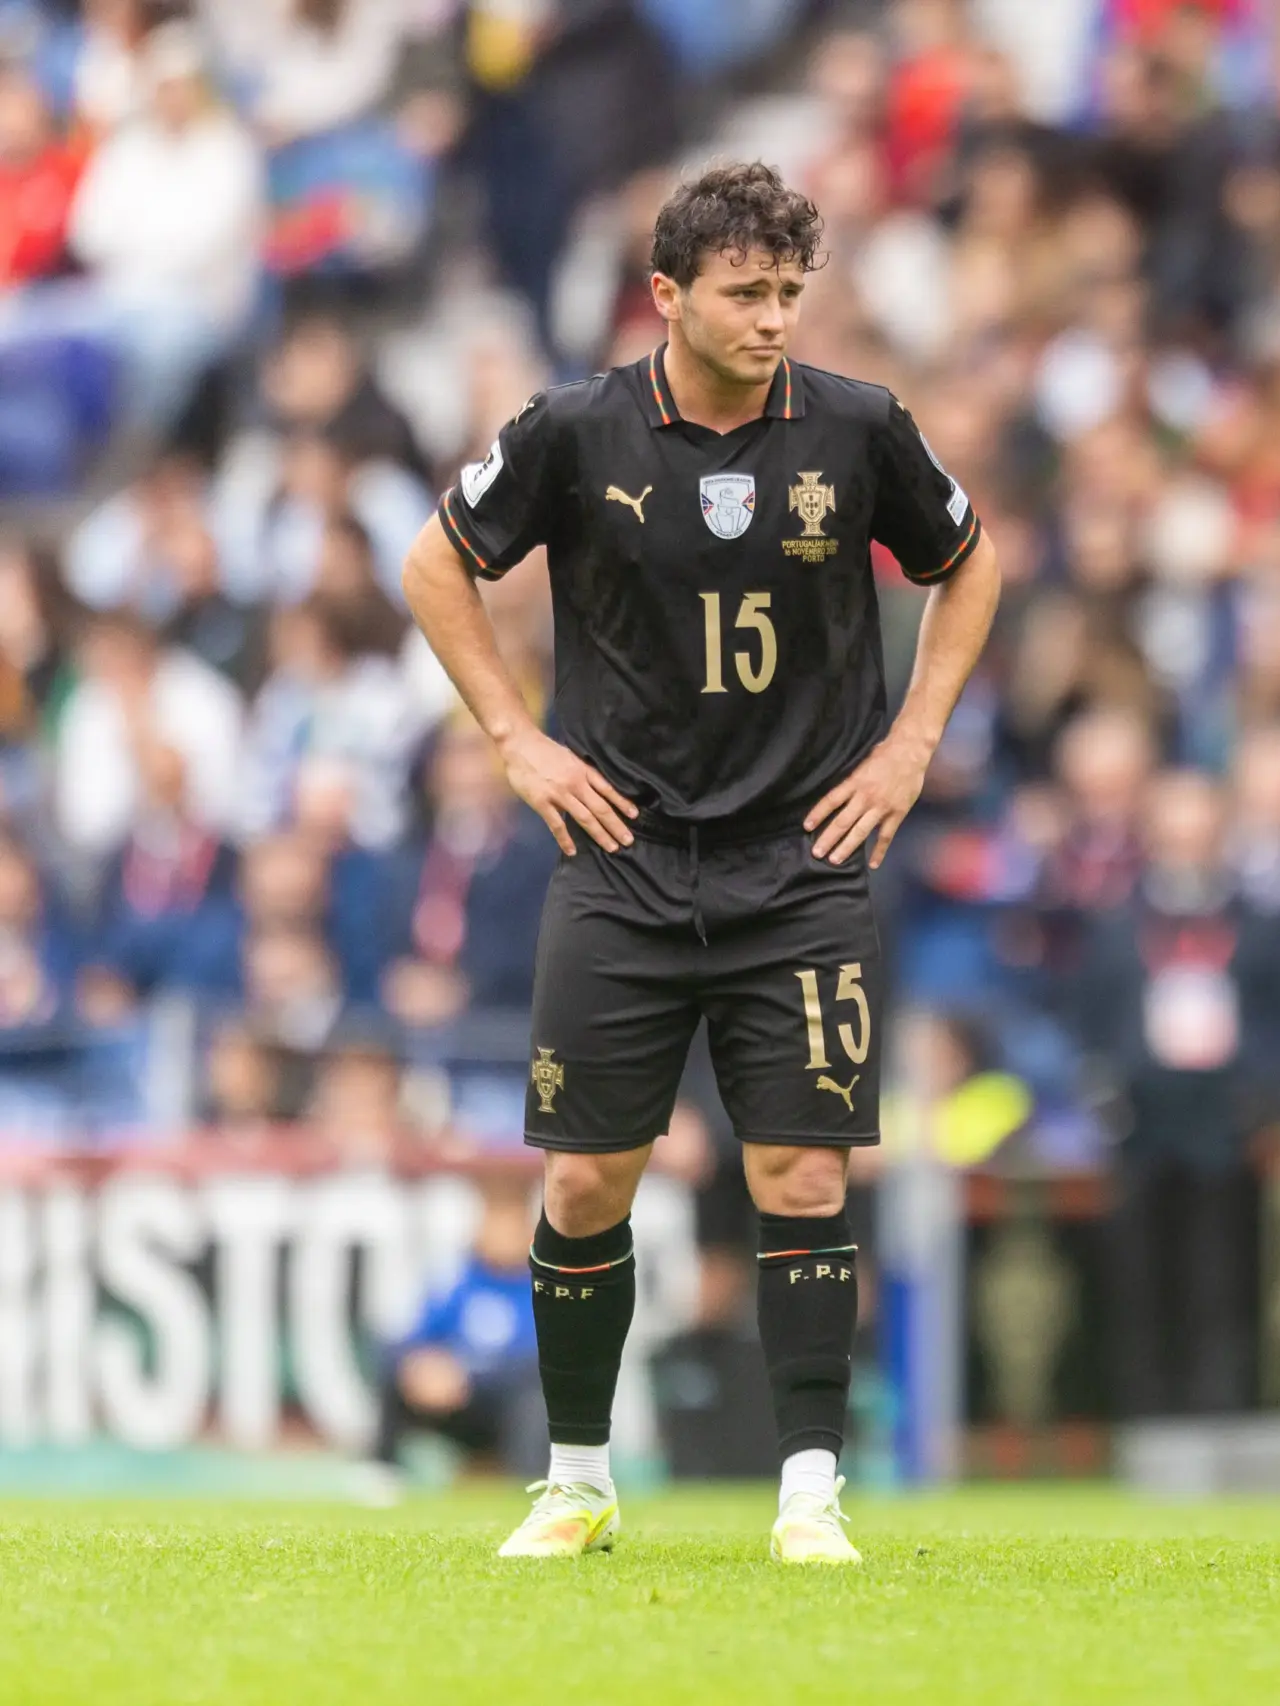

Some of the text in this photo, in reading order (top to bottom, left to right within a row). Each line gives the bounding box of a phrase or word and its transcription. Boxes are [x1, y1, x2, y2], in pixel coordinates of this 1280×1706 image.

[792, 547, 826, 556] NOVEMBRO
[803, 554, 825, 563] PORTO
[698, 592, 777, 694] 15
[793, 962, 871, 1070] 15
